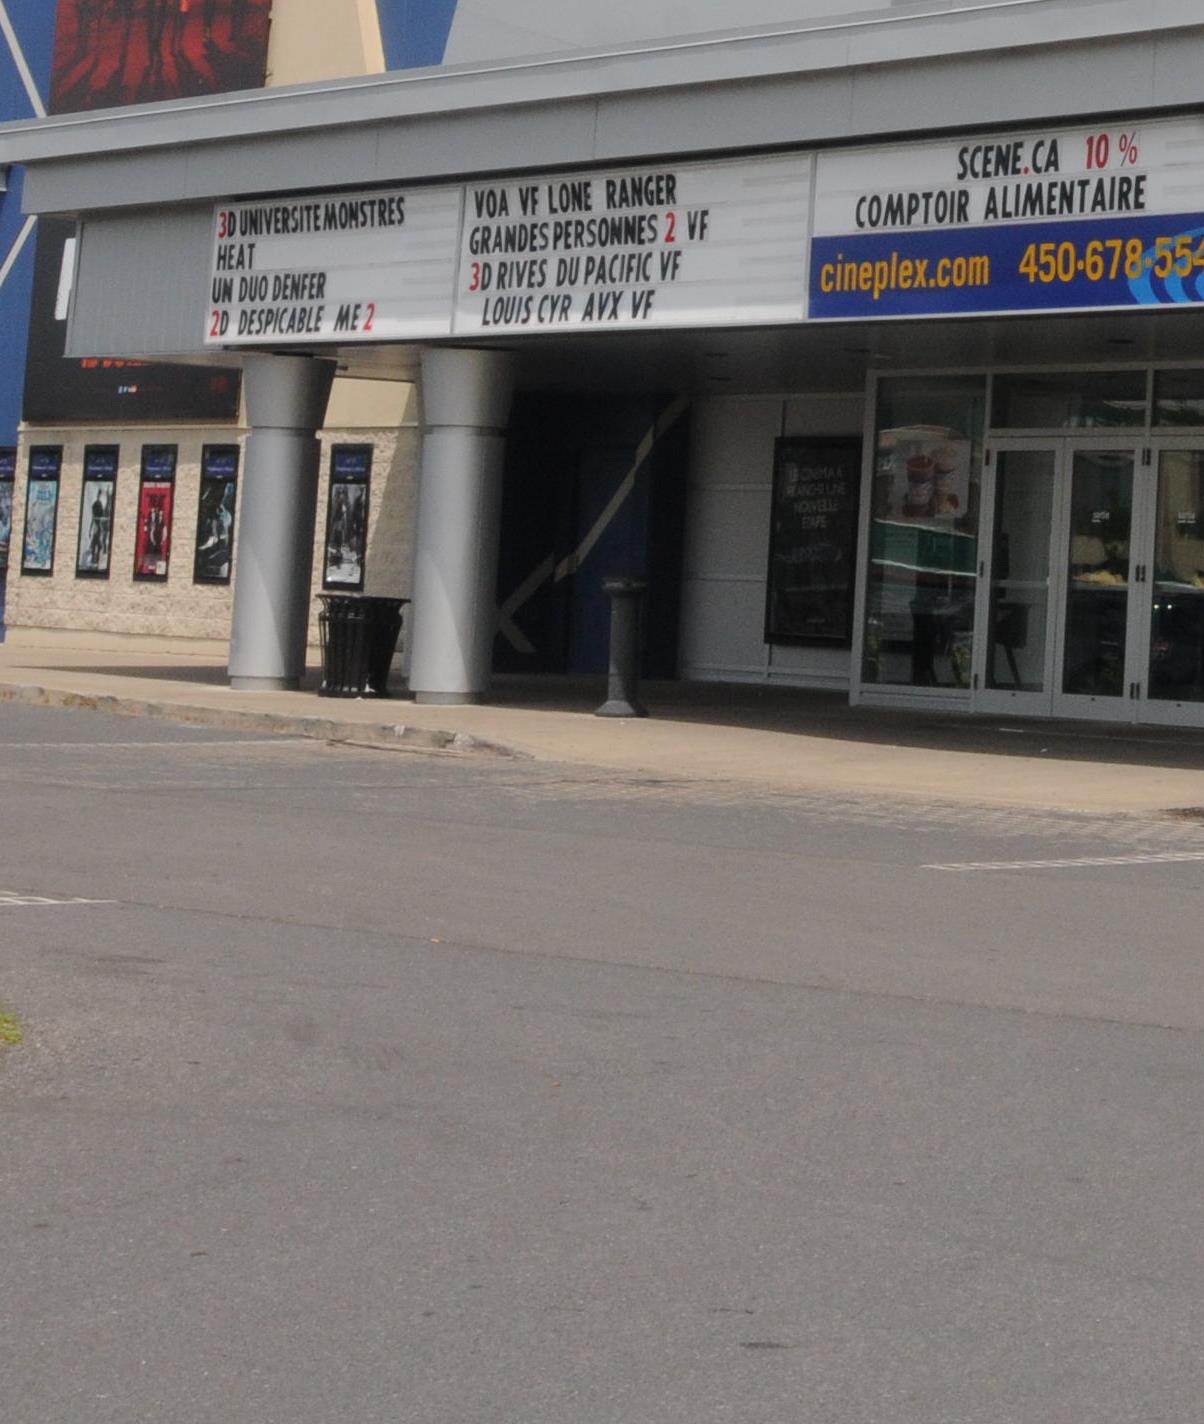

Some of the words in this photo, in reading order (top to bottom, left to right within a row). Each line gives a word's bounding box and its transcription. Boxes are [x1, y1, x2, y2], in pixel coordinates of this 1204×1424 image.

[956, 139, 1060, 180] SCENE.CA
[1086, 134, 1109, 169] 10
[474, 190, 510, 218] VOA
[518, 186, 538, 216] VF
[548, 182, 592, 214] LONE
[606, 174, 676, 210] RANGER
[855, 190, 968, 228] COMPTOIR
[984, 175, 1146, 221] ALIMENTAIRE
[219, 209, 236, 238] 3D
[470, 222, 548, 255] GRANDES
[553, 214, 658, 250] PERSONNES
[664, 212, 676, 242] 2
[688, 210, 709, 240] VF
[216, 243, 256, 270] HEAT
[469, 262, 492, 291] 3D
[496, 258, 547, 290] RIVES
[556, 257, 580, 287] DU
[584, 252, 652, 284] PACIFIC
[660, 250, 682, 281] VF
[820, 252, 990, 300] cineplex.com
[212, 277, 233, 303] UN
[238, 275, 268, 302] DUO
[272, 272, 326, 301] DENFER
[482, 296, 531, 326] LOUIS
[537, 294, 572, 323] CYR
[582, 291, 622, 322] AVX
[631, 290, 655, 319] VF
[210, 310, 229, 336] 2D
[238, 306, 324, 336] DESPICABLE
[334, 304, 361, 332] ME
[363, 304, 376, 331] 2
